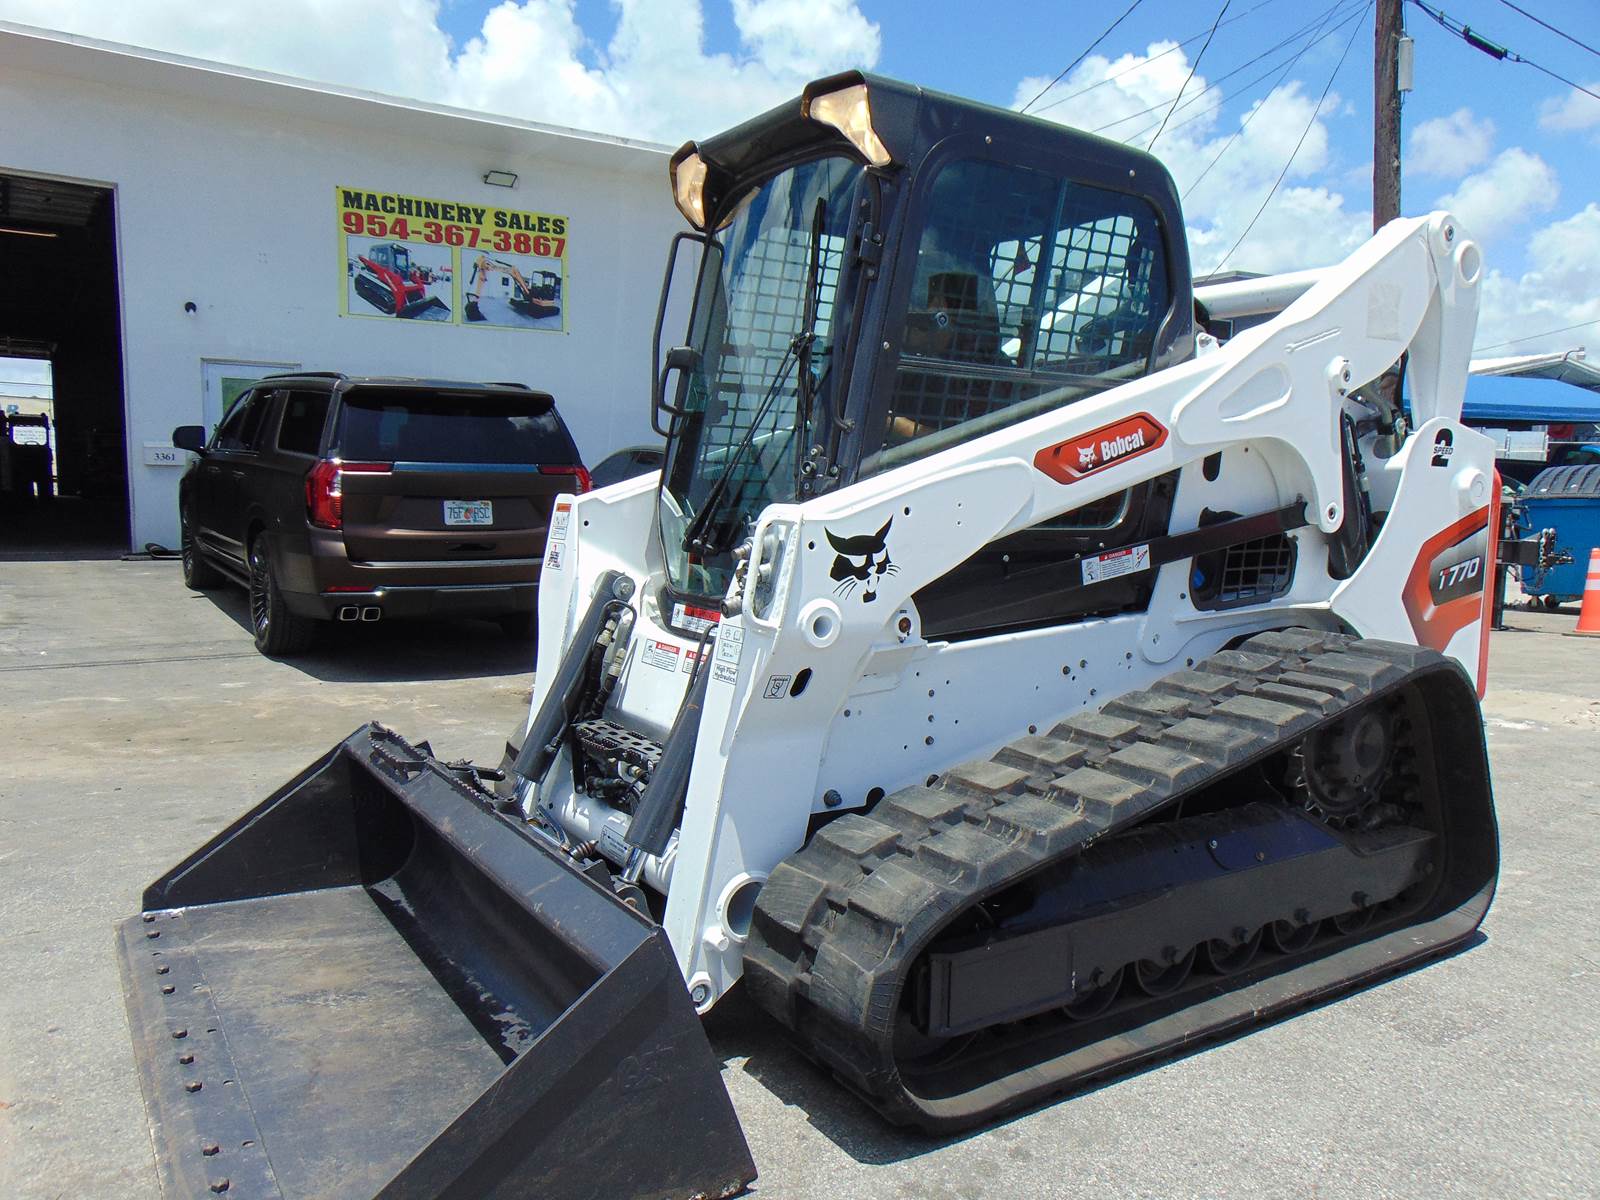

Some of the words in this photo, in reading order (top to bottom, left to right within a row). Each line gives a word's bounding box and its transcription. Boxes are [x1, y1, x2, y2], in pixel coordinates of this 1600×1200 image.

[342, 190, 486, 225] MACHINERY
[494, 210, 565, 235] SALES
[343, 211, 566, 257] 954-367-3867
[154, 452, 175, 461] 3361
[1101, 428, 1145, 461] Bobcat
[1433, 446, 1454, 455] SPEED
[1109, 550, 1127, 559] DANGER
[1439, 557, 1480, 590] T770
